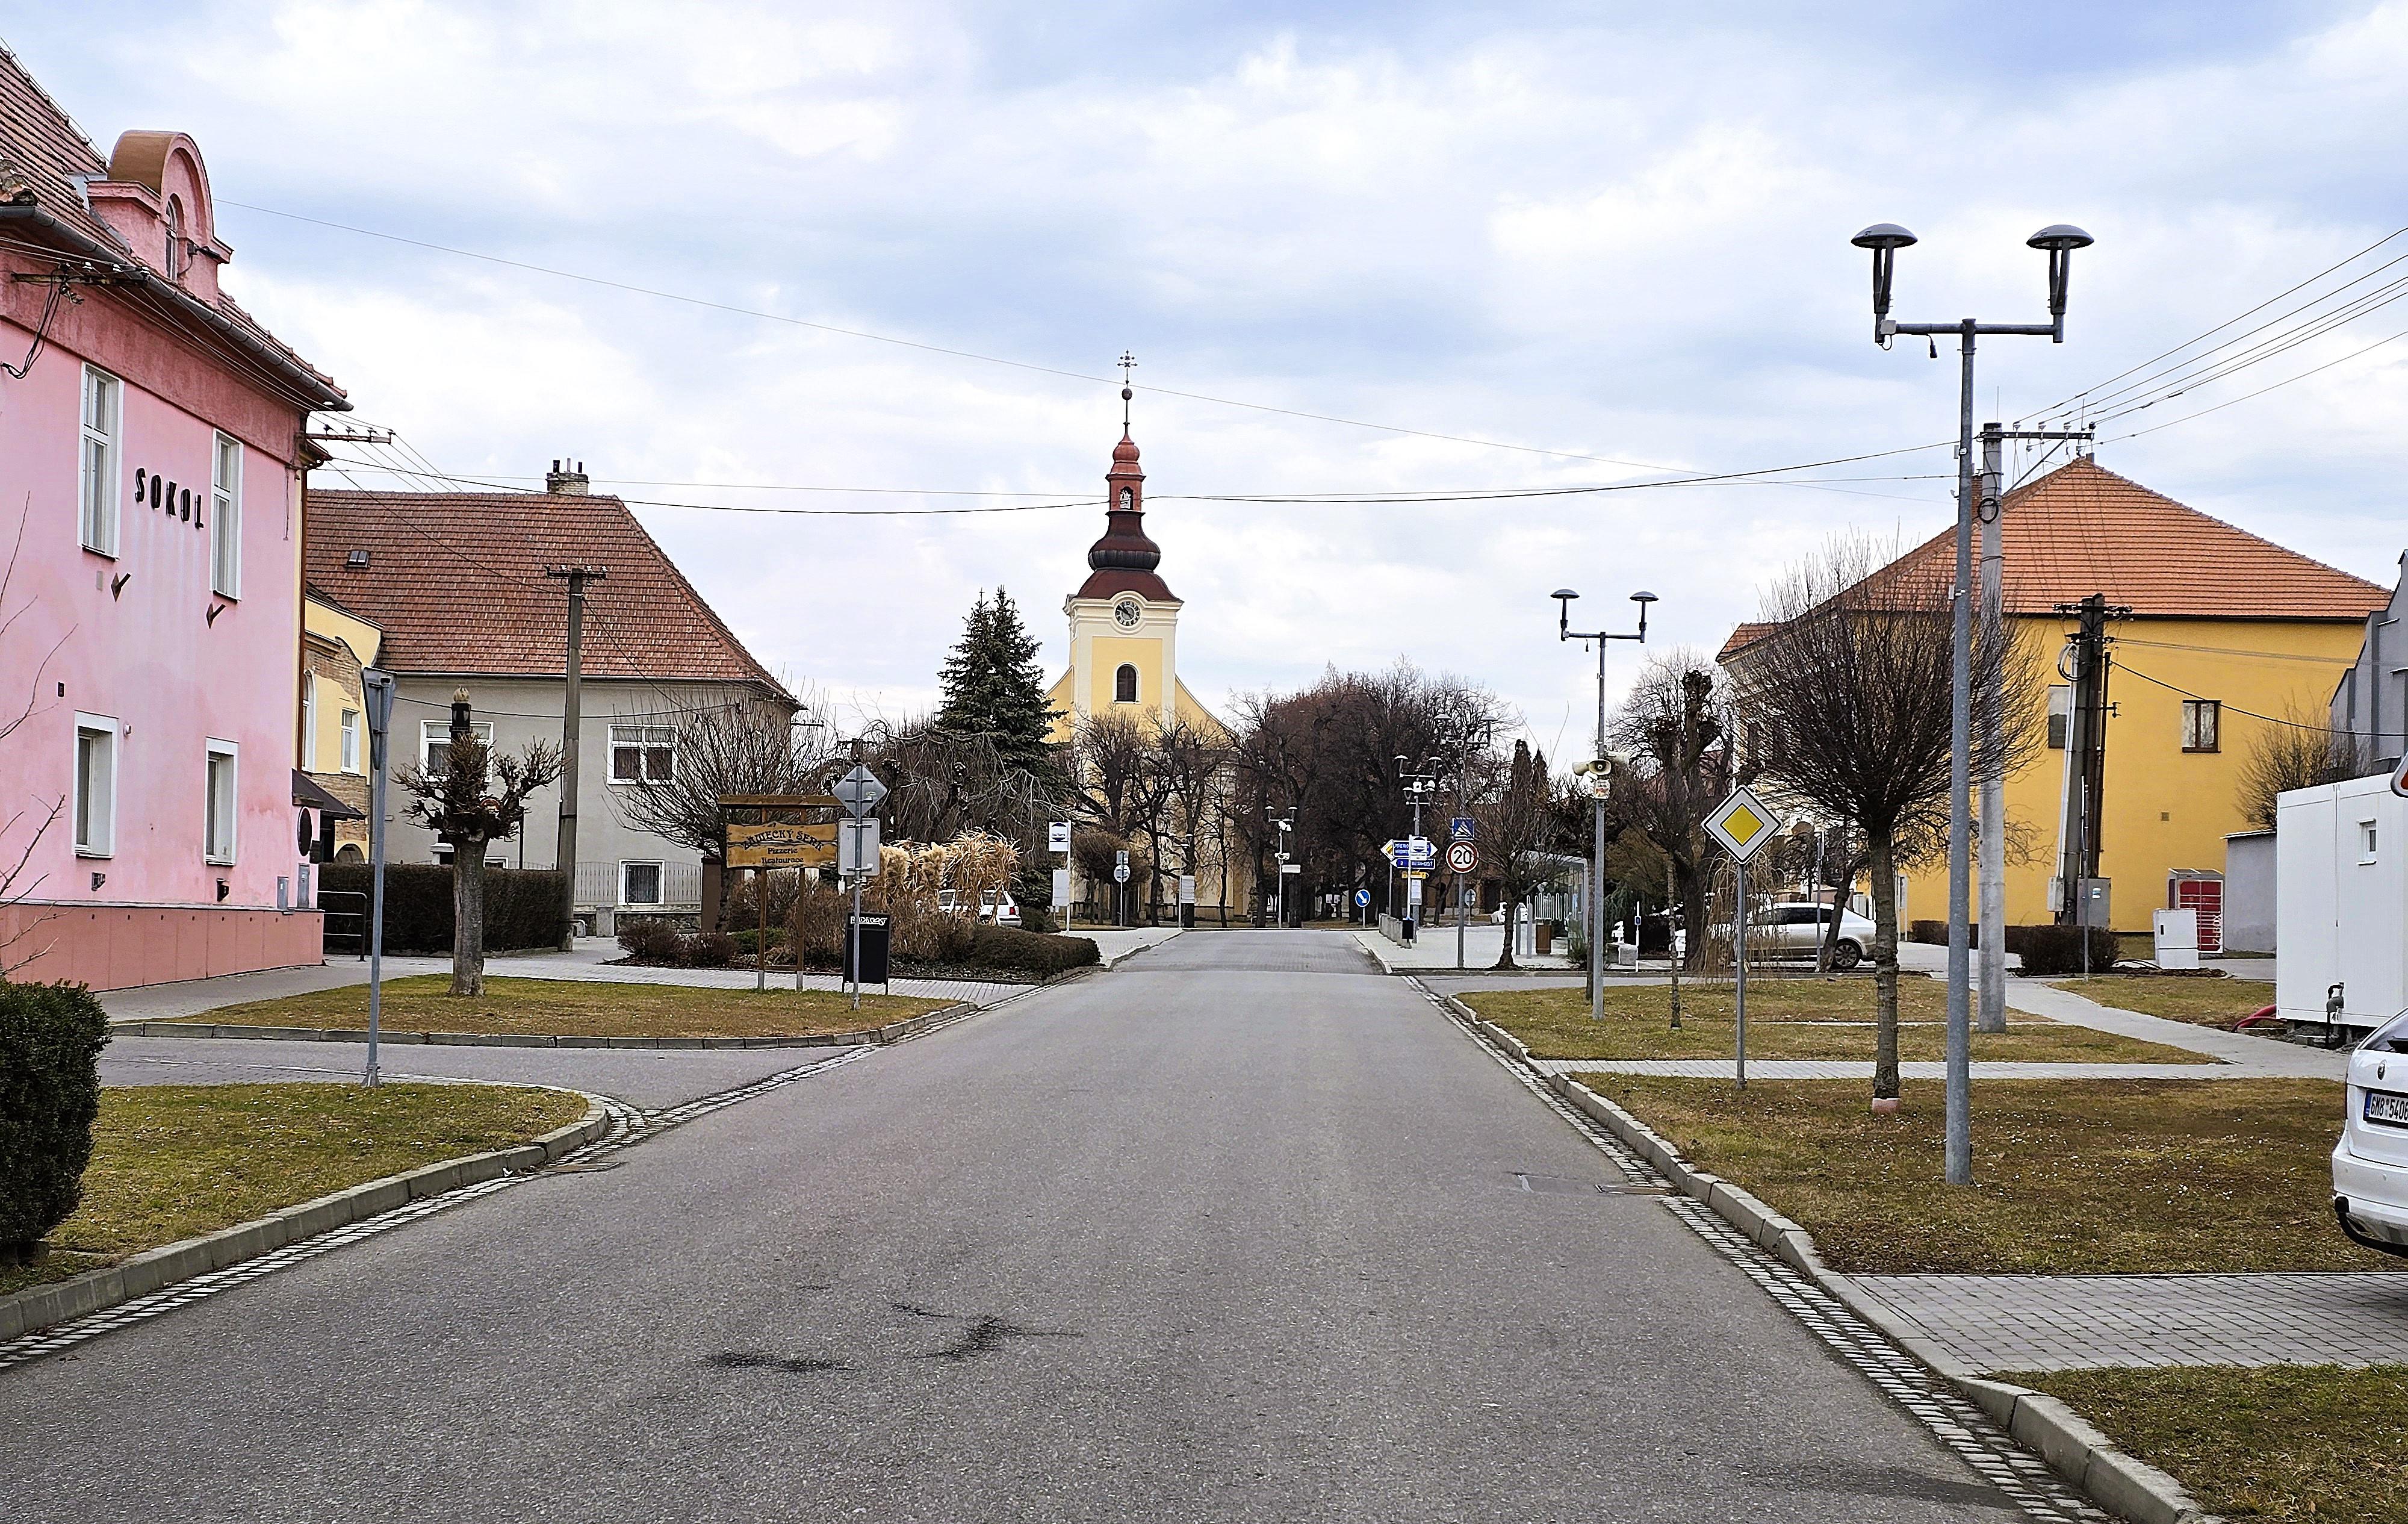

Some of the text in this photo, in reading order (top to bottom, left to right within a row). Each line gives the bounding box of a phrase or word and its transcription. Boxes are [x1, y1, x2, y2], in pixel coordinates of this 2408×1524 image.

[135, 467, 203, 529] SOKOL
[1453, 850, 1472, 864] 20
[2371, 1096, 2385, 1116] 6M8
